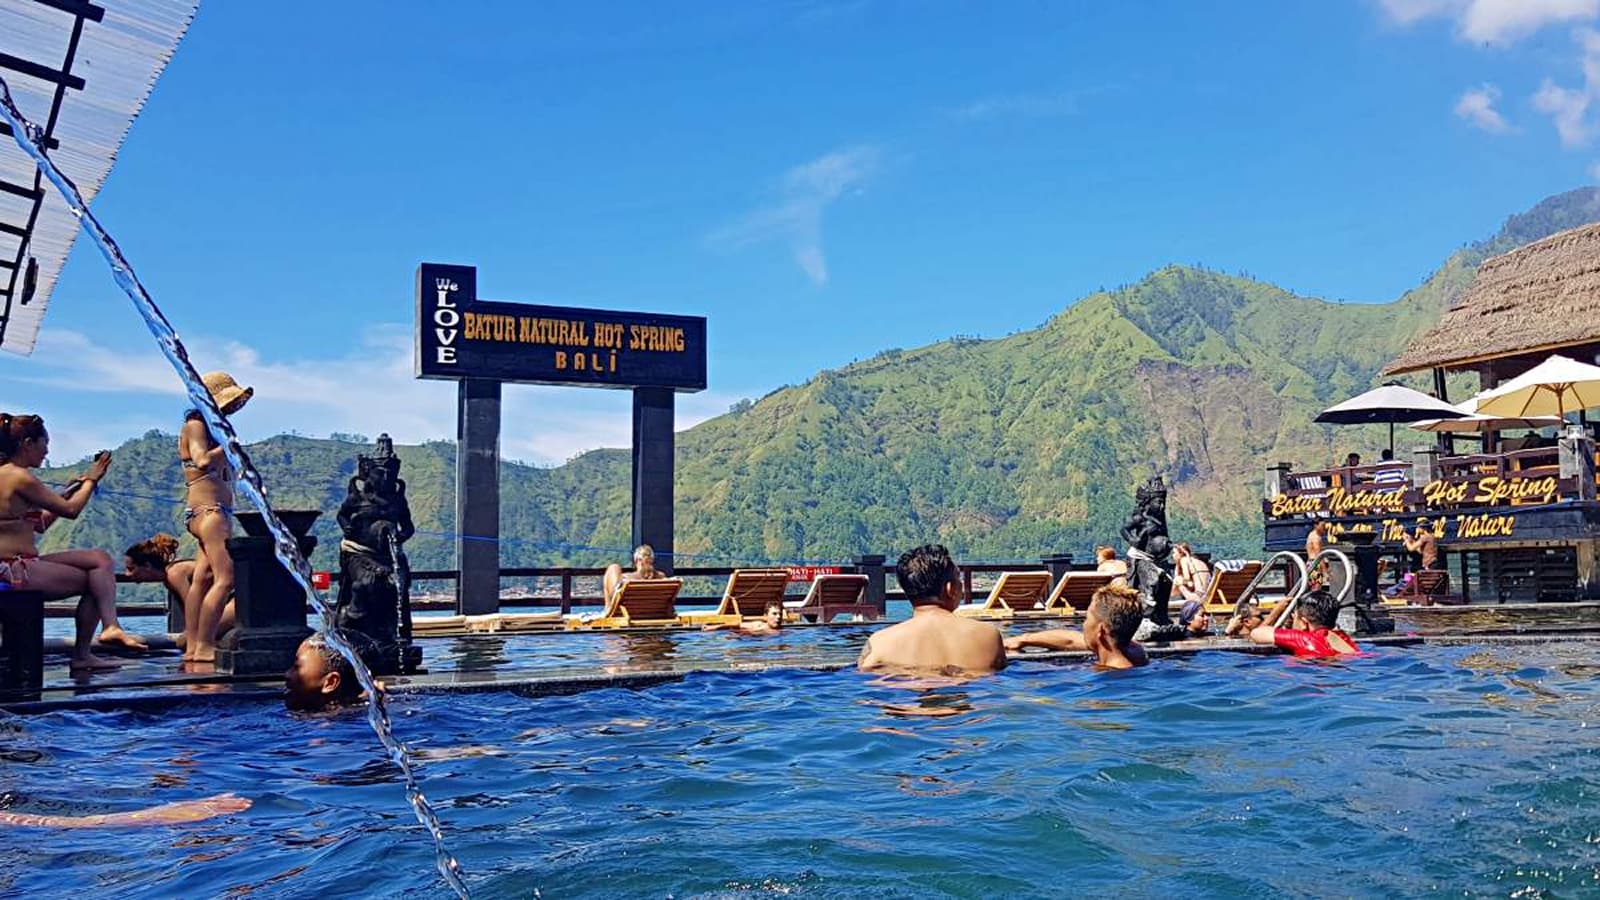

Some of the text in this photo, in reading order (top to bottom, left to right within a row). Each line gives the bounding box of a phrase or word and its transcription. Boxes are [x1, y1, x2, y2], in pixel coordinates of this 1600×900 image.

[435, 277, 459, 291] We
[433, 290, 460, 364] LOVE
[463, 311, 685, 352] BATUR NATURAL HOT SPRING
[1271, 476, 1558, 516] Batur Natural Hot Spring
[1457, 514, 1515, 538] Nature
